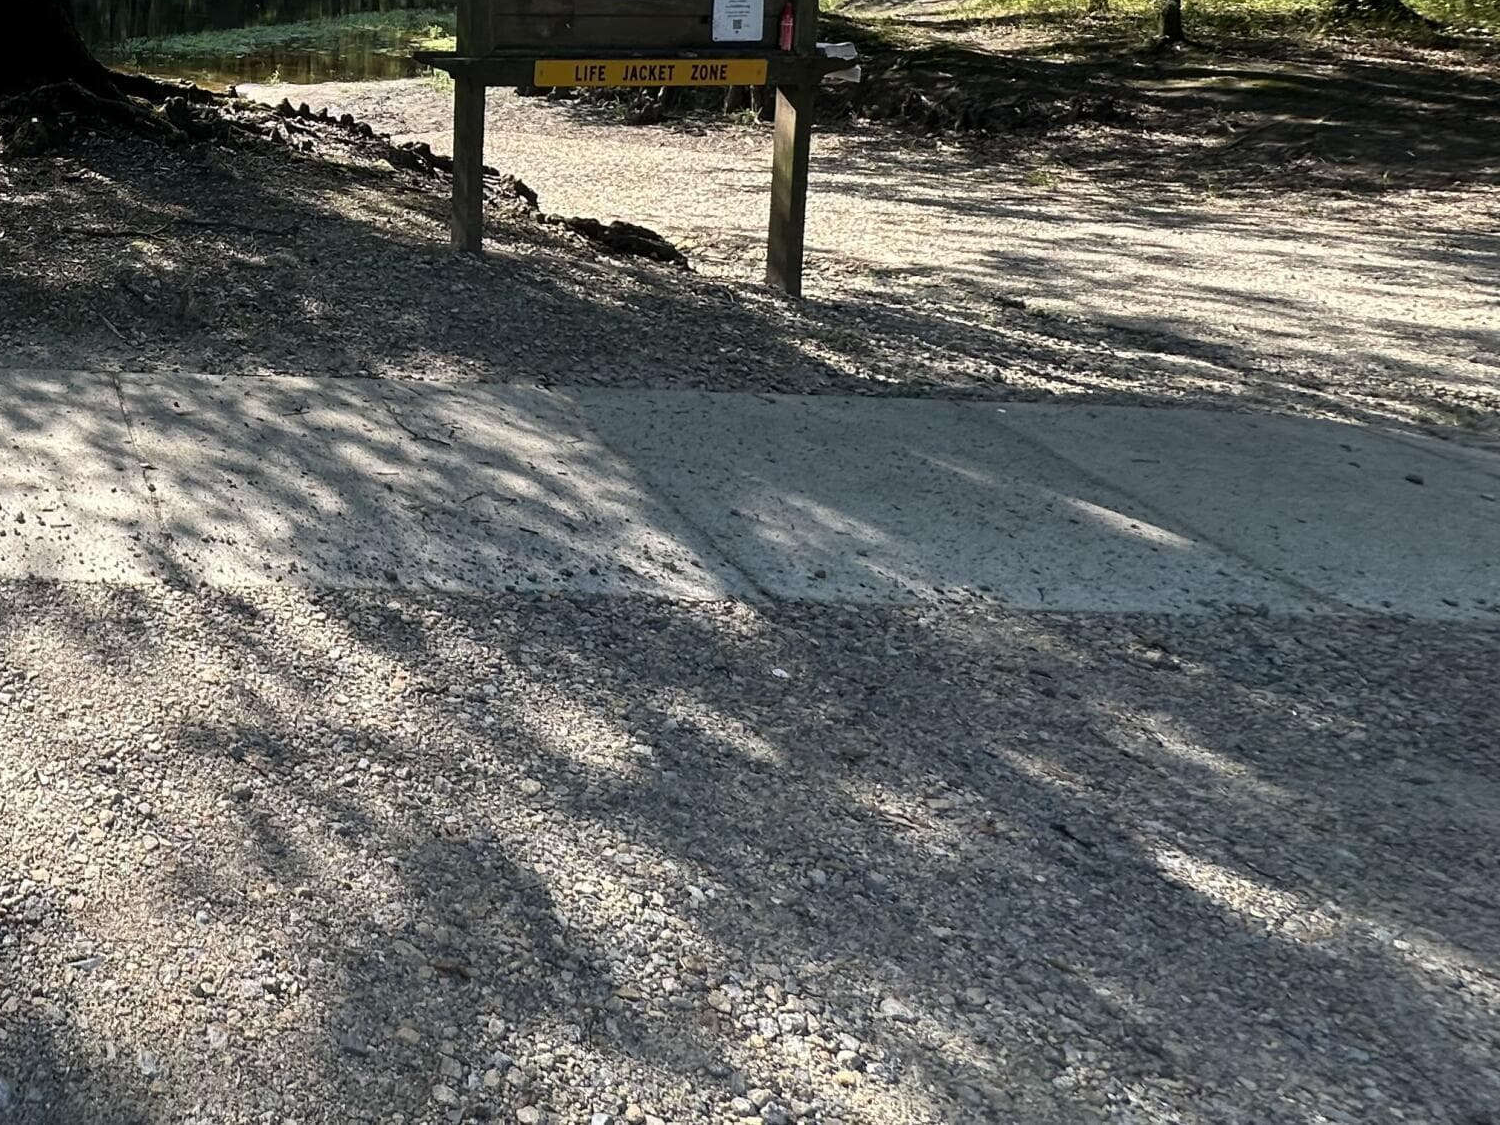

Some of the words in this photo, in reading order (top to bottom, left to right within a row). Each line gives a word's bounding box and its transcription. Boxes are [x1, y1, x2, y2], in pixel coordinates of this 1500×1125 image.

[575, 65, 606, 81] LIFE
[622, 65, 675, 81] JACKET
[691, 64, 728, 80] ZONE
